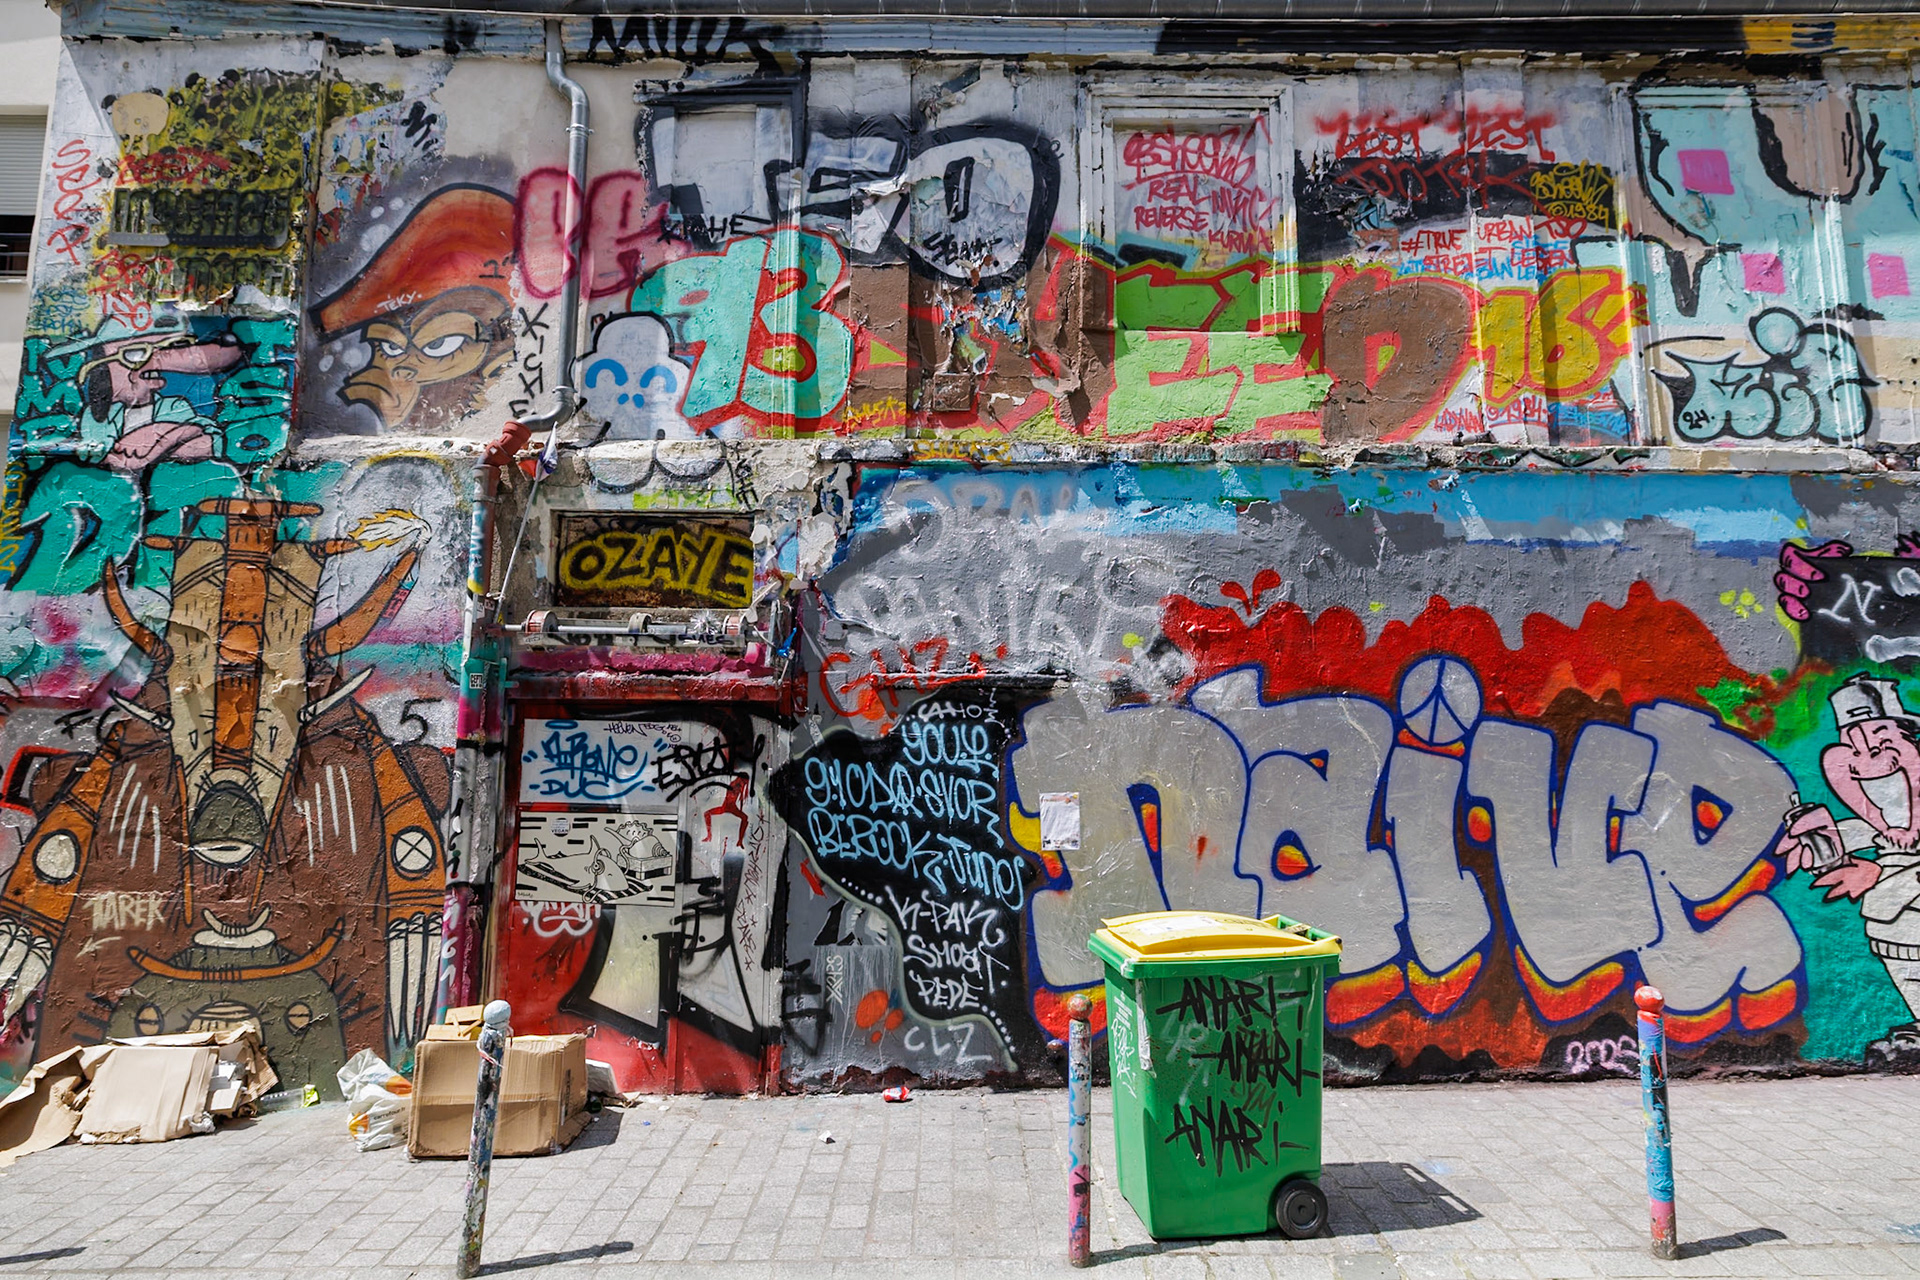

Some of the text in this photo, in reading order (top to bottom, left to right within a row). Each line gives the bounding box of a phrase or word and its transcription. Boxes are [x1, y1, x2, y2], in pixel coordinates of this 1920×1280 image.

[1133, 205, 1210, 232] REVERSE
[1401, 229, 1468, 256] #TRUE
[1477, 215, 1532, 243] URBAN
[561, 528, 754, 606] OZAYE
[83, 893, 166, 931] TAREK
